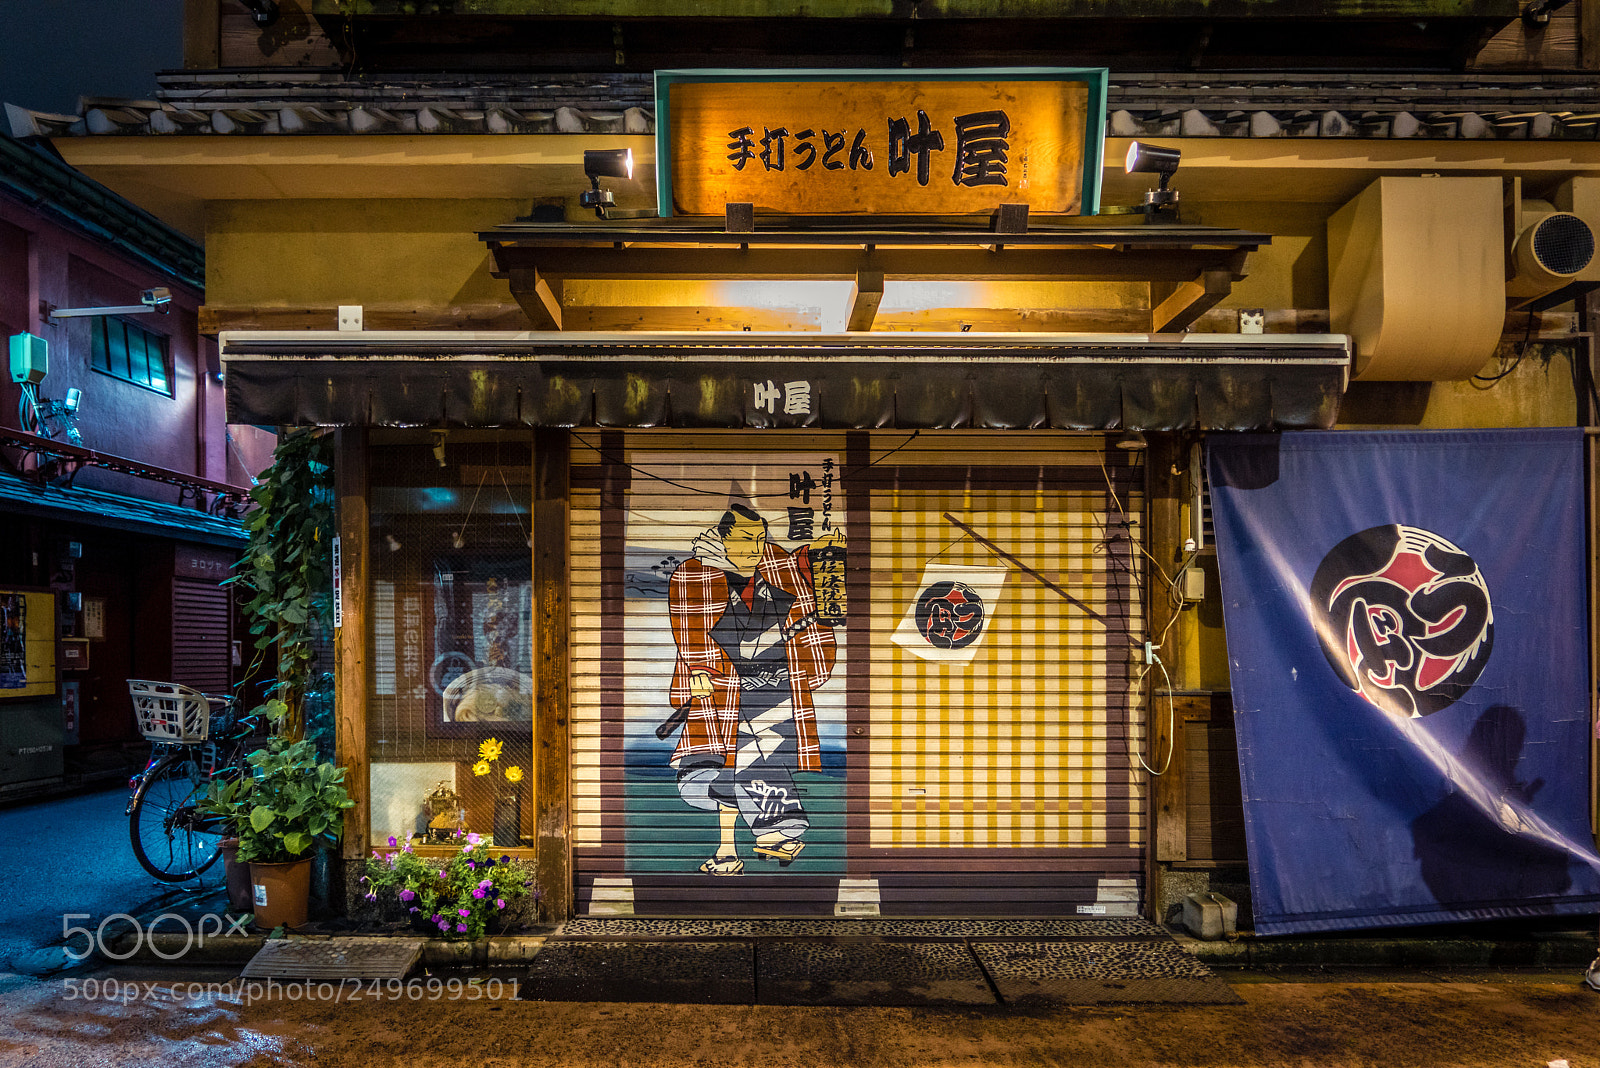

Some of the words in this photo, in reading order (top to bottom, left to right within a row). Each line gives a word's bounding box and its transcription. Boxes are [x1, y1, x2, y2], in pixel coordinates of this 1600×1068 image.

[726, 125, 875, 172] 手打うどん
[887, 109, 1011, 187] 叶屋
[753, 379, 811, 415] 叶屋
[787, 470, 817, 540] 叶屋
